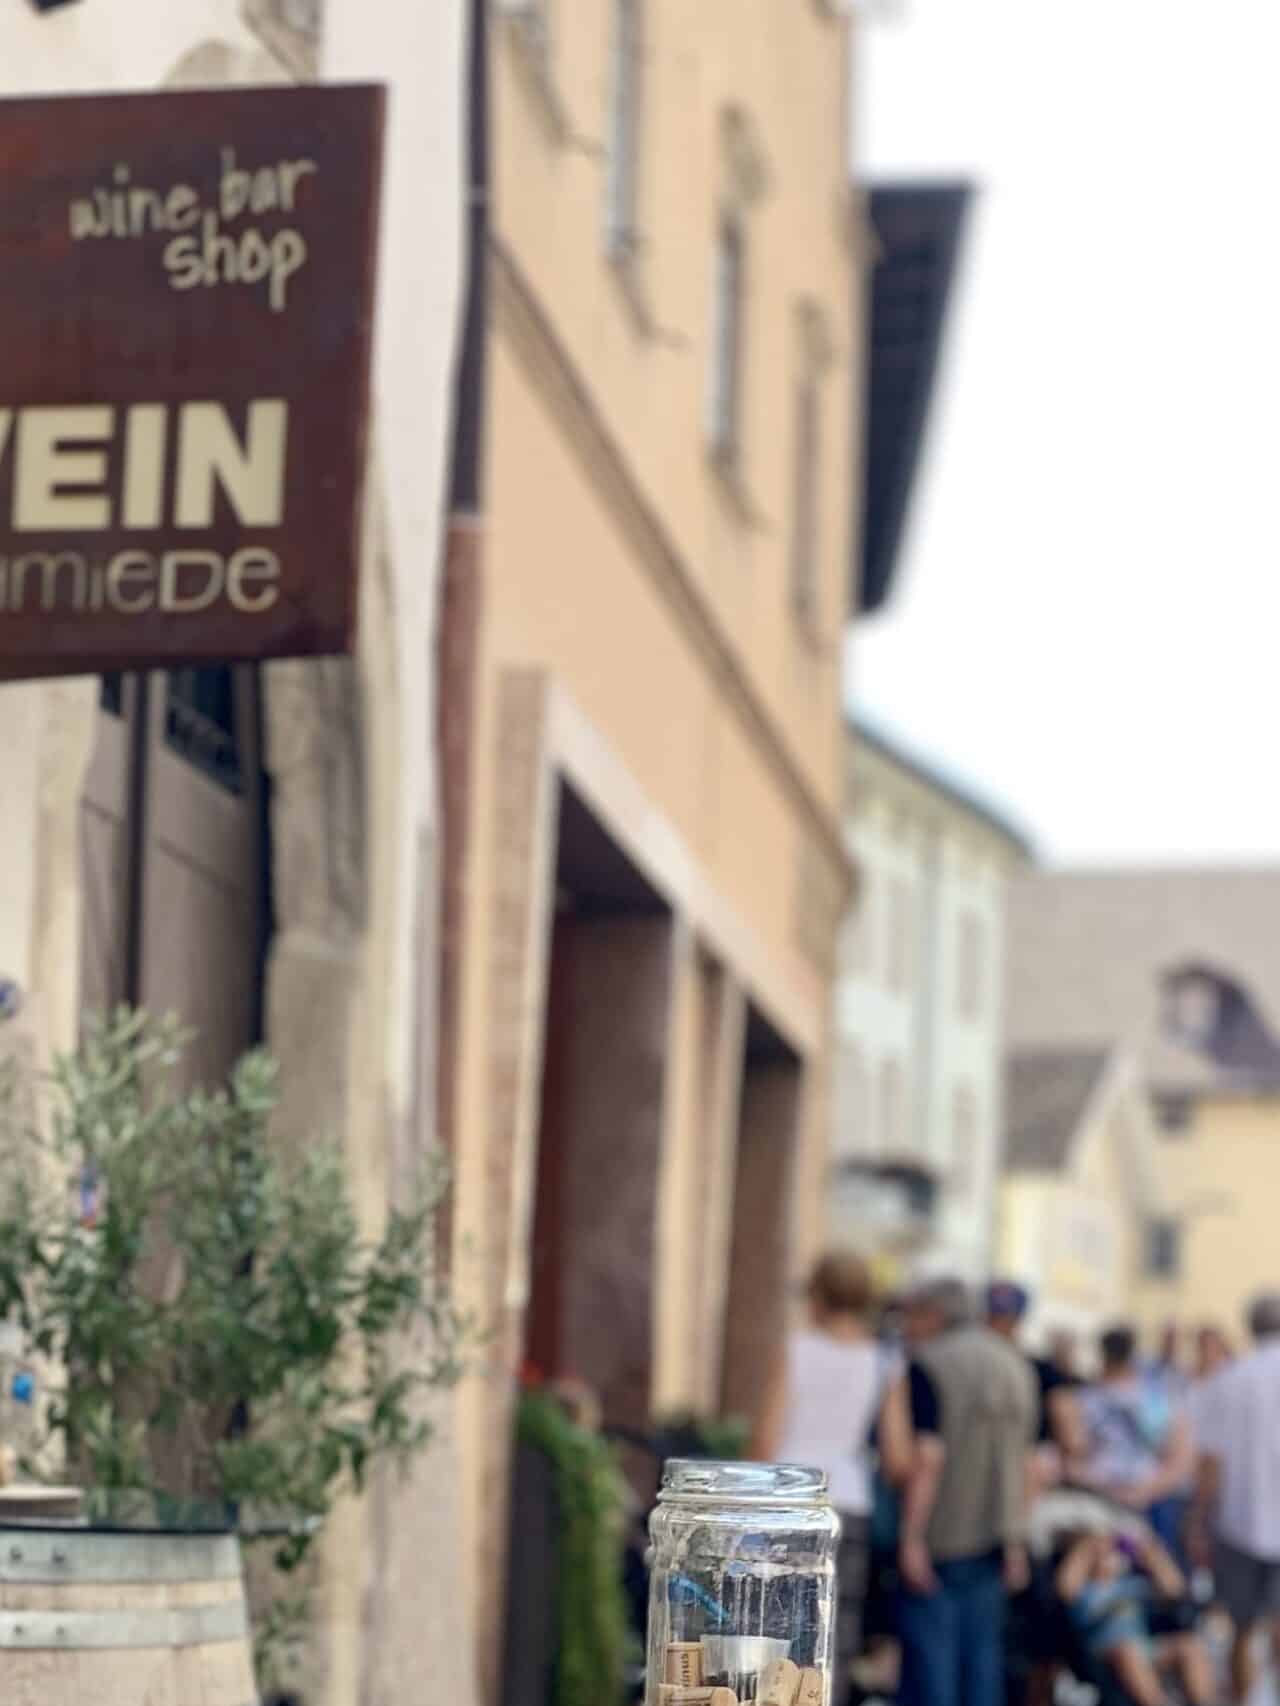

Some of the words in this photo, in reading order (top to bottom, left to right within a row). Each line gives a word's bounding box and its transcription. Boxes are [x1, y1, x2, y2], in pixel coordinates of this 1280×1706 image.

[70, 163, 198, 238] wine
[220, 147, 317, 219] bar
[164, 210, 306, 311] shop
